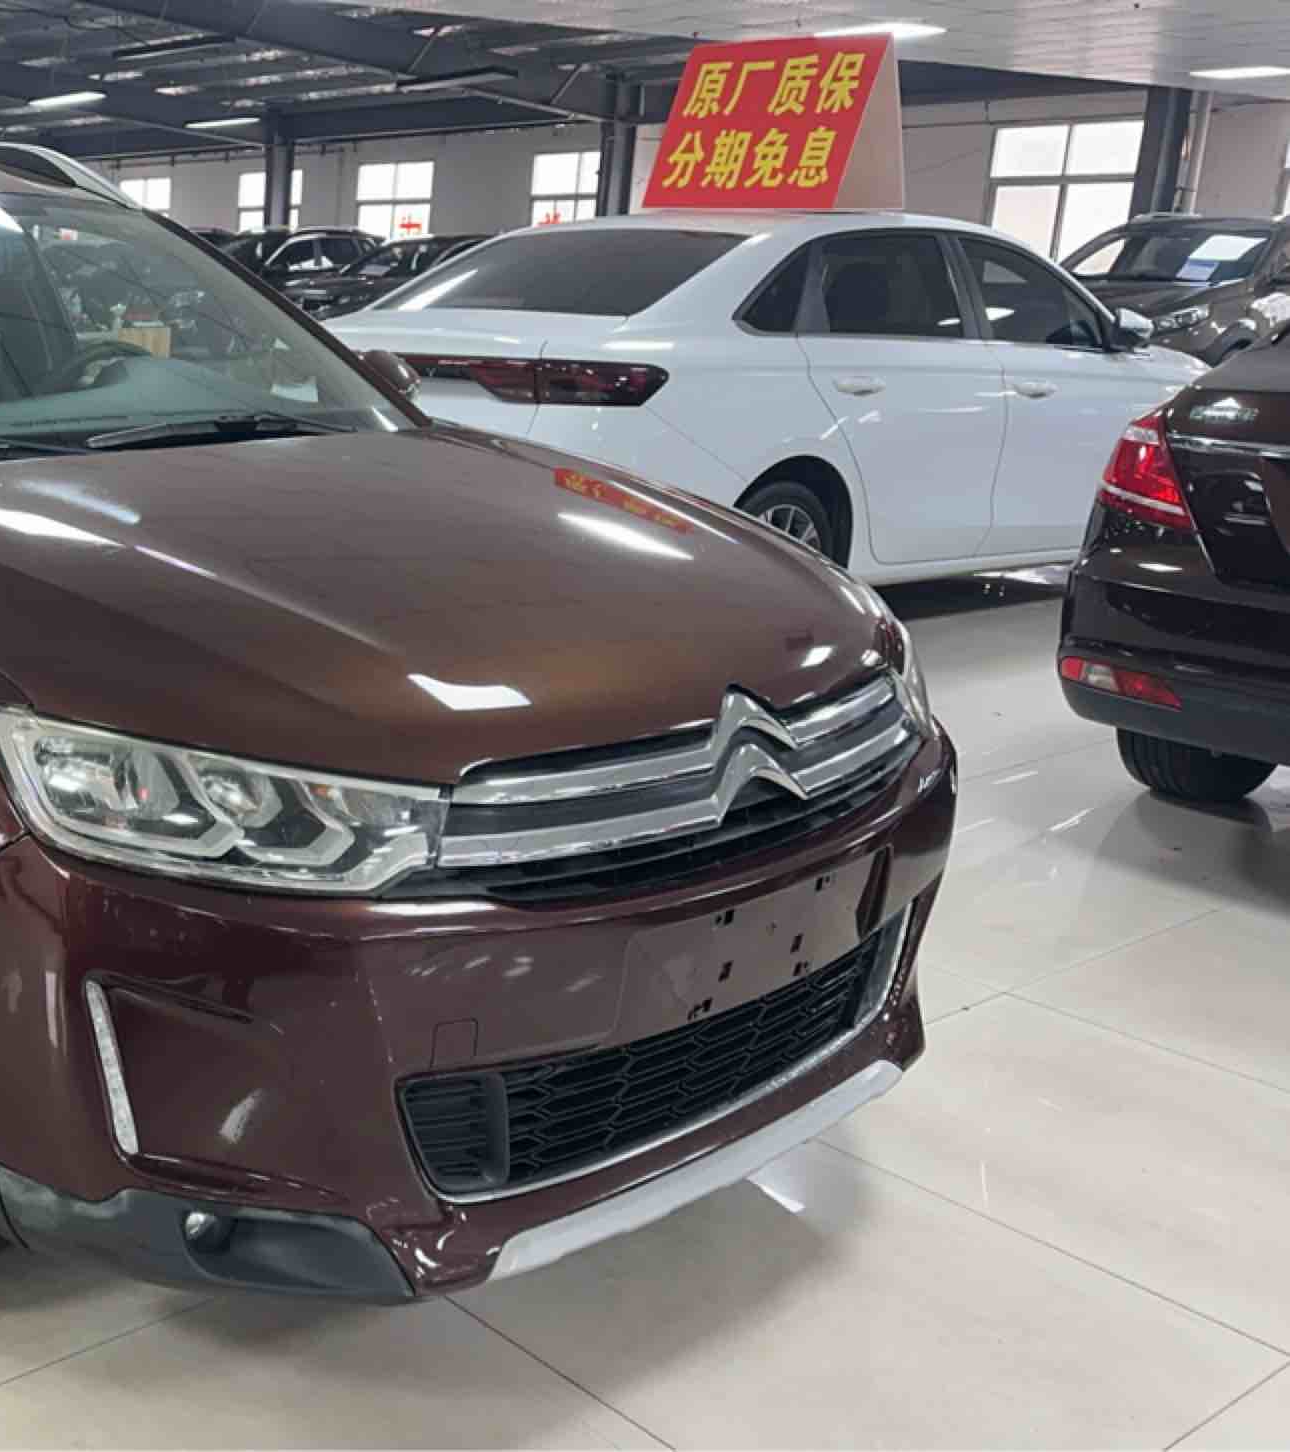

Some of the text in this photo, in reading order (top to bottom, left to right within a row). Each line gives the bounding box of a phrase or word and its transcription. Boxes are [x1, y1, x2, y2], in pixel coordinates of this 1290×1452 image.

[683, 51, 865, 118] 原厂质保
[662, 126, 836, 189] 分期免息
